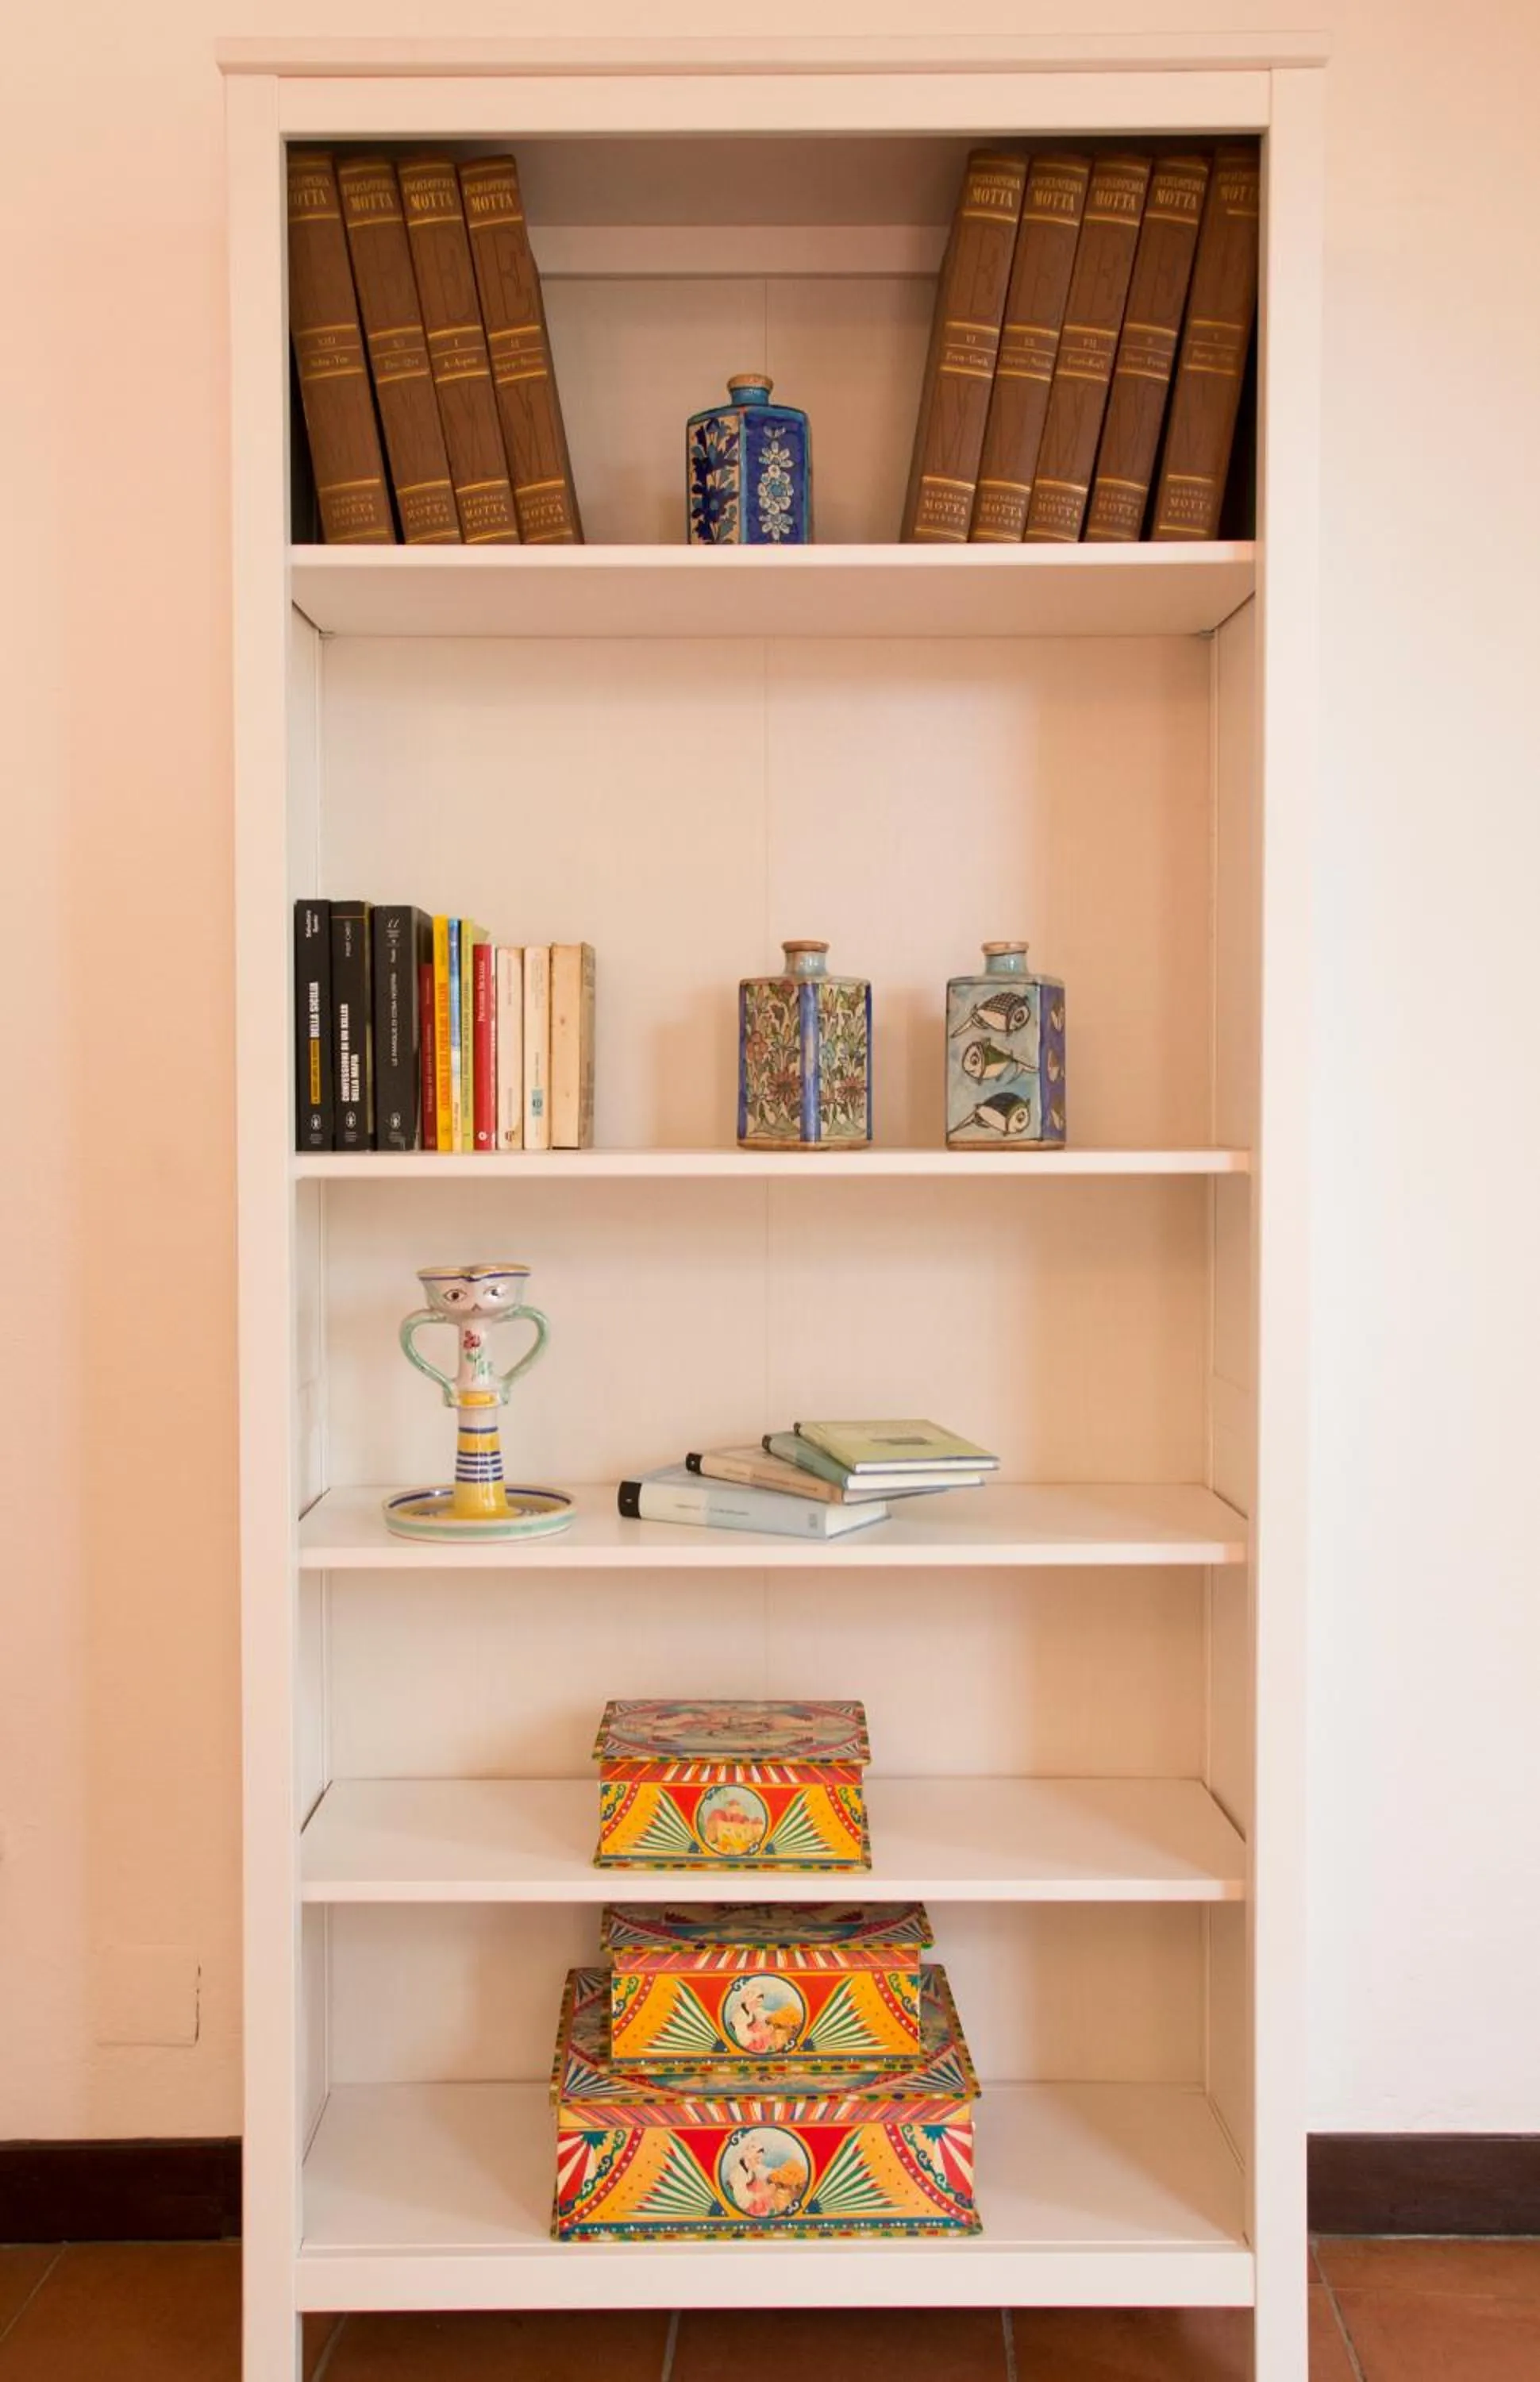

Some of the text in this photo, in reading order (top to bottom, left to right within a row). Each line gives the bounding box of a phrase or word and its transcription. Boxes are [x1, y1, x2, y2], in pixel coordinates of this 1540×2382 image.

[289, 189, 328, 206] OTTA
[349, 192, 395, 210] MOTTA
[410, 191, 454, 210] MOTTA
[471, 193, 514, 212] MOTTA
[972, 187, 1014, 208] MOTTA
[1034, 190, 1075, 211] MOTTA
[1095, 190, 1136, 211] MOTTA
[1155, 189, 1197, 210] MOTTA
[407, 504, 449, 519] MOTTA
[464, 503, 506, 519] MOTTA
[925, 499, 966, 515] MOTTA
[981, 503, 1022, 518] MOTTA
[1038, 503, 1079, 518] MOTTA
[1098, 501, 1138, 517] MOTTA
[310, 981, 319, 1012] SICILIA
[310, 1013, 319, 1038] DELLA
[340, 1004, 350, 1102] CONFESSIONI DI UN KILLER
[350, 1054, 360, 1102] DELLA MAFIA
